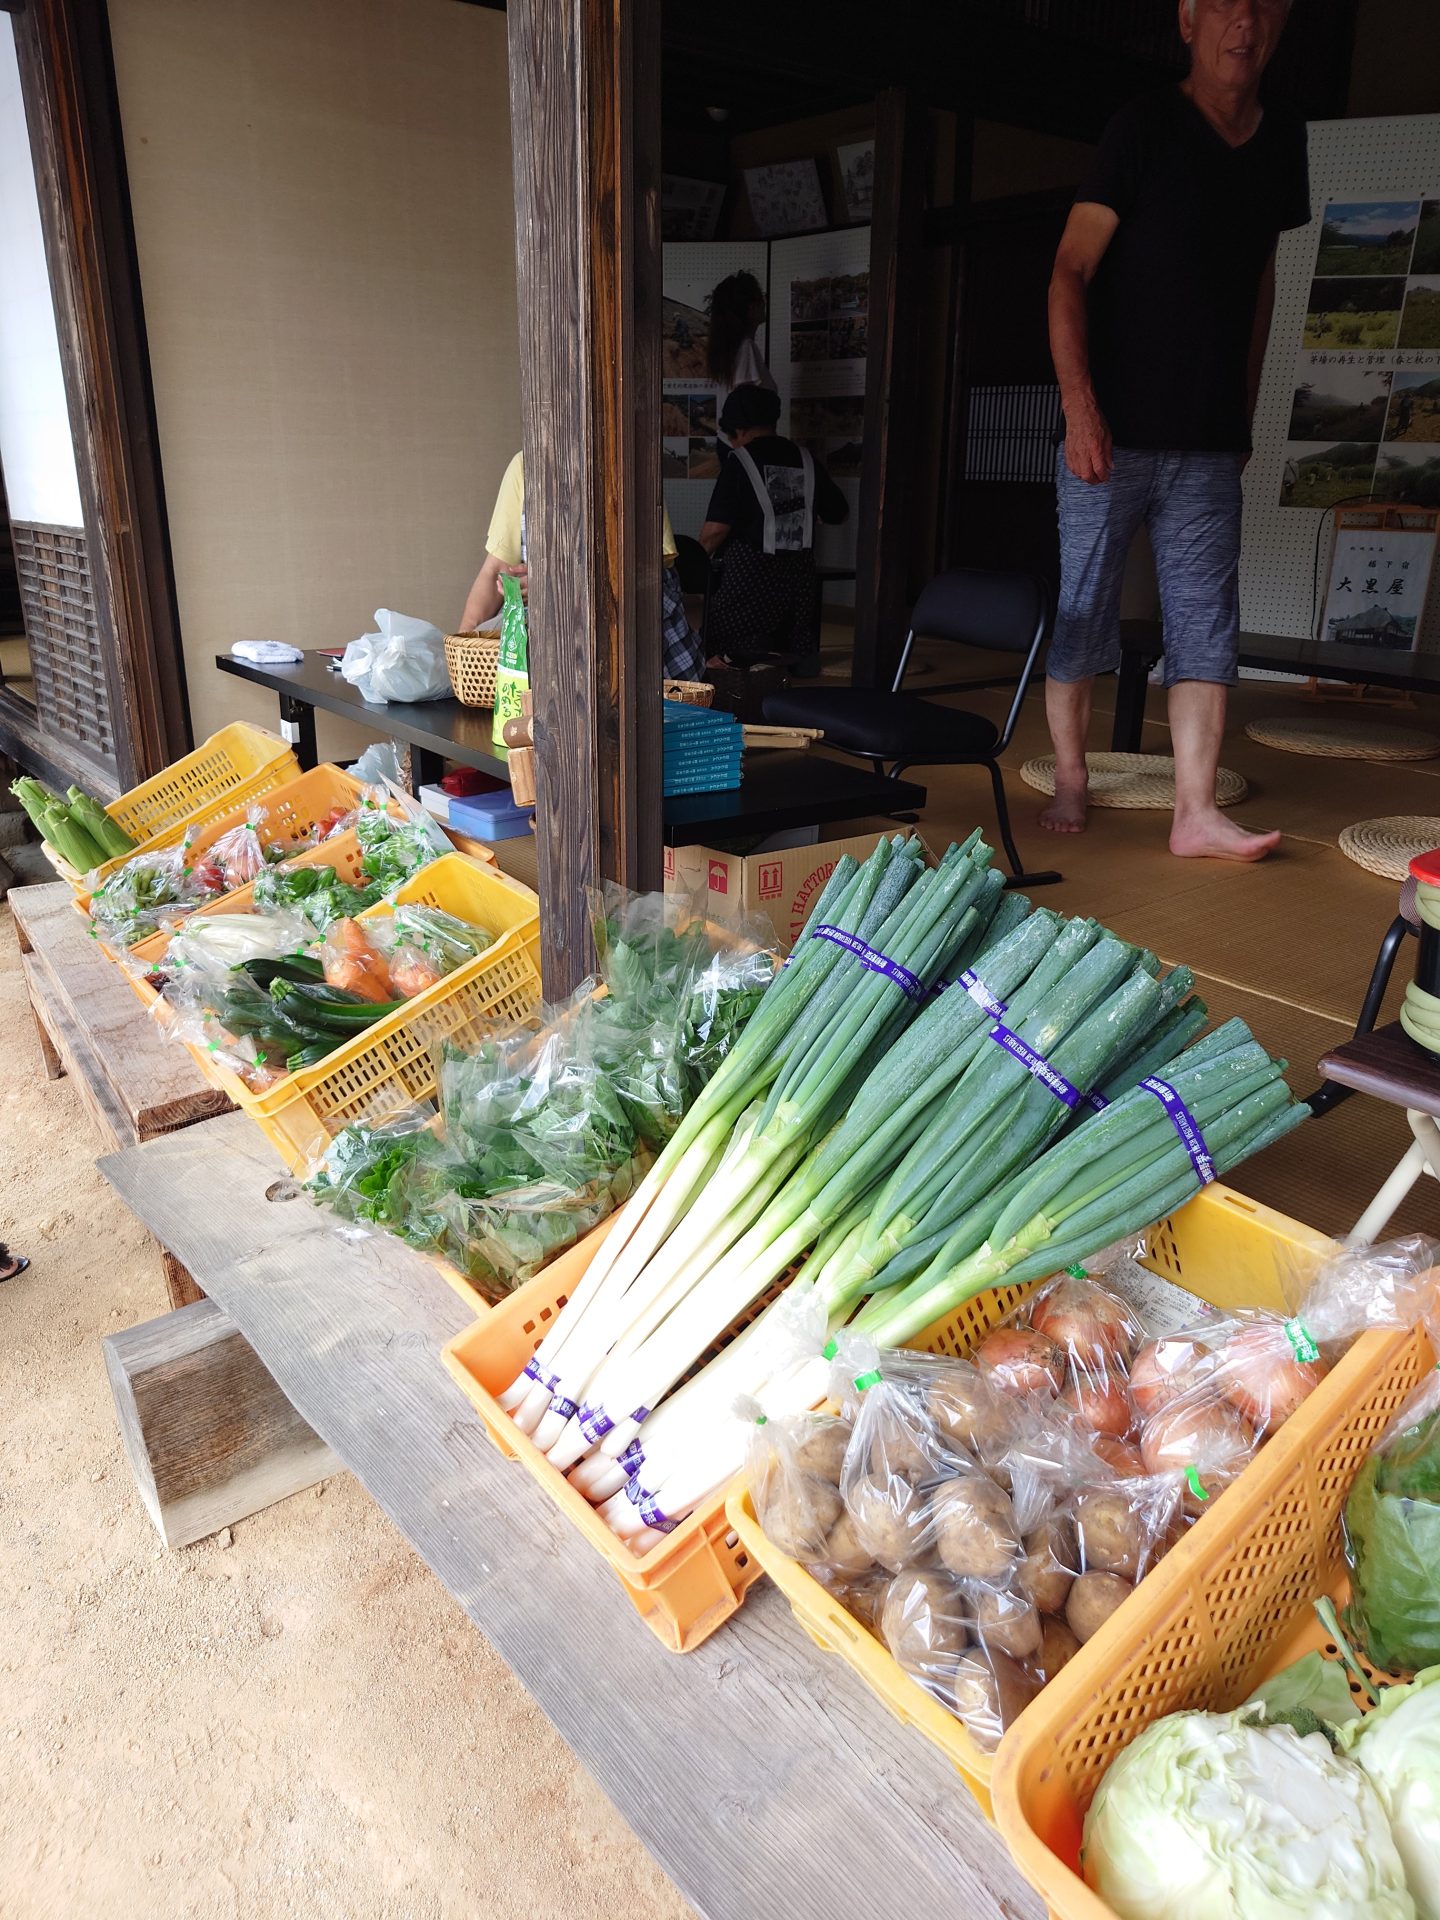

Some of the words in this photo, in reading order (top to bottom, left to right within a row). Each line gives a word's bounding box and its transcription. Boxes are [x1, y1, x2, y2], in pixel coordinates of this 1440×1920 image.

[1336, 576, 1405, 595] 大黒屋
[791, 860, 839, 915] HATTOR
[1002, 1034, 1028, 1057] VEGETABLES
[1175, 1111, 1194, 1139] VEGETABLES
[1189, 1137, 1201, 1153] FRESH
